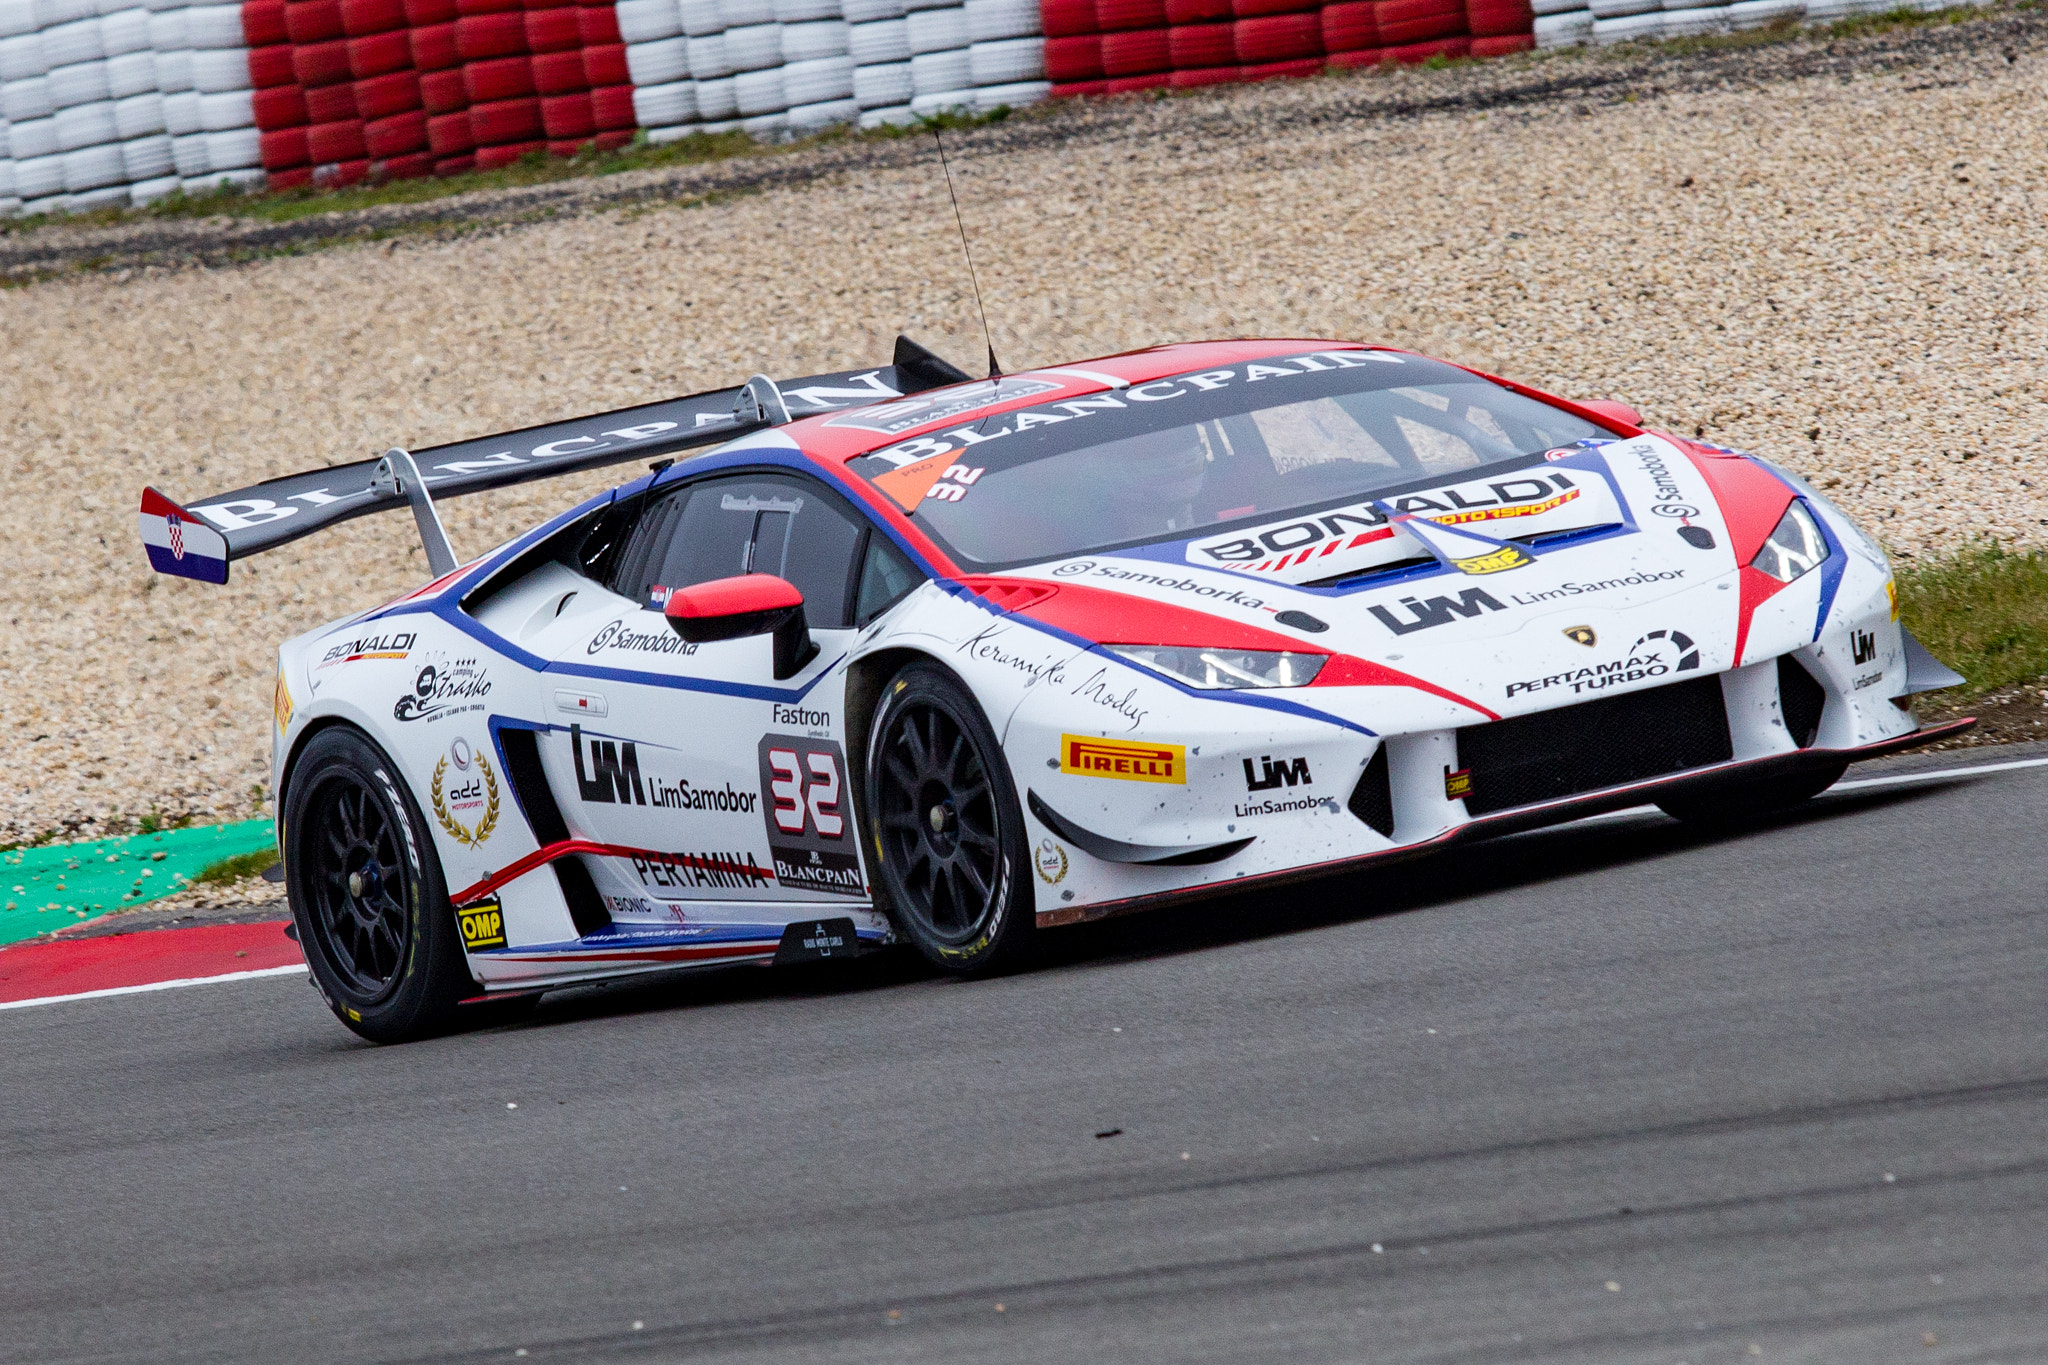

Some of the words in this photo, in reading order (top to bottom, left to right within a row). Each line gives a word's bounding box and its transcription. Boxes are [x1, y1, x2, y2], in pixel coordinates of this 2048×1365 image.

[867, 350, 1405, 470] BLANCPAIN
[901, 463, 934, 477] PRO
[925, 463, 986, 503] 32
[1628, 444, 1683, 501] Samoborka
[1200, 472, 1577, 562] BONALDI
[1456, 551, 1520, 572] OMP
[1091, 565, 1264, 609] Samoborka
[1510, 568, 1686, 605] LimSamobor
[322, 633, 417, 662] BONALDI
[609, 626, 698, 657] Samoborka
[452, 668, 474, 679] camping
[1505, 652, 1663, 699] PERTAMAX
[1569, 664, 1670, 694] TURBO
[774, 704, 830, 727] Fastron
[1070, 741, 1174, 777] PIRELLI
[450, 778, 482, 800] add
[649, 777, 757, 813] LimSamobor
[768, 746, 844, 838] 32
[1234, 796, 1335, 817] LimSamobor
[629, 851, 770, 889] PERTAMINA
[776, 860, 861, 886] BLANCPAIN
[462, 911, 501, 940] OMP
